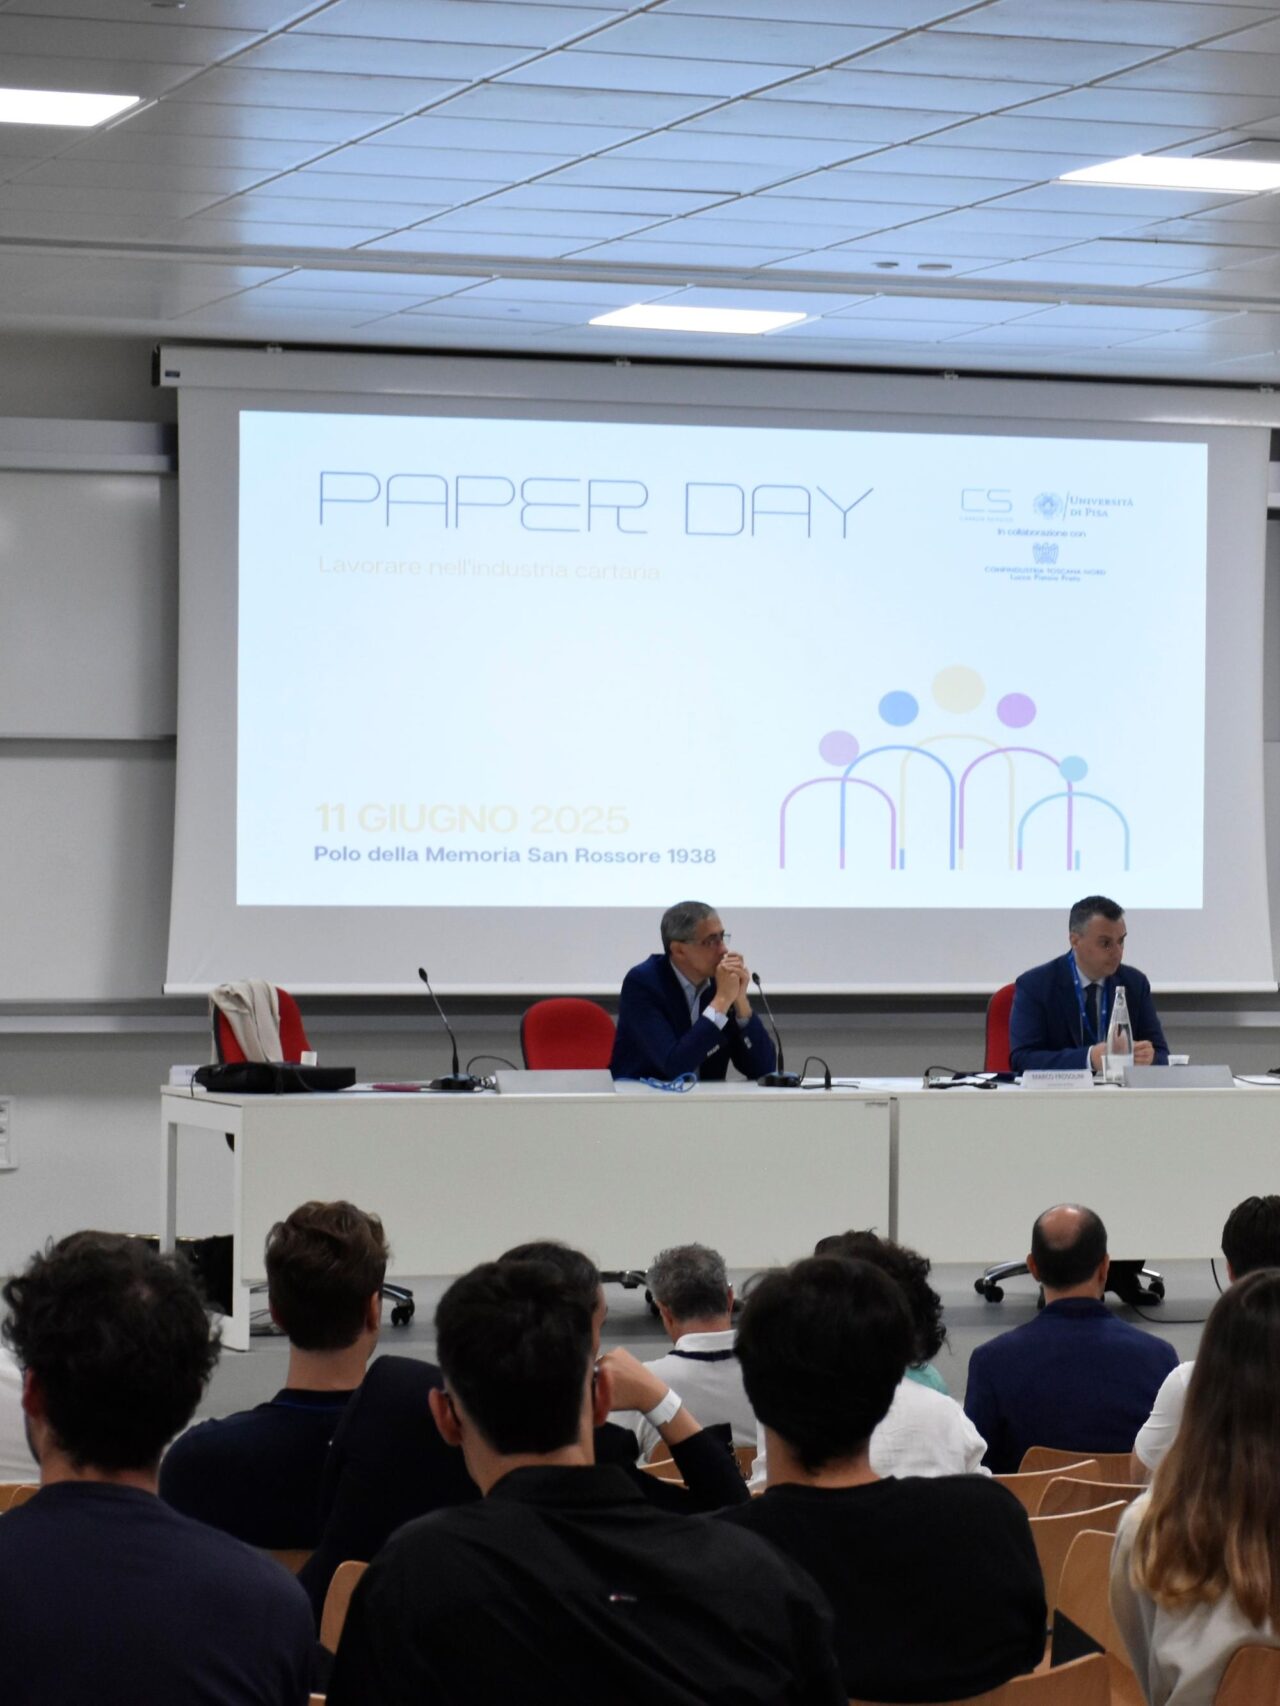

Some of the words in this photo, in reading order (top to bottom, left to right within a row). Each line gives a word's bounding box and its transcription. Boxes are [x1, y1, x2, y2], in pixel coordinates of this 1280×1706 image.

[319, 470, 649, 535] PAPER
[684, 481, 875, 539] DAY
[960, 487, 1013, 513] CS
[1069, 496, 1134, 507] UNIVERSITÀ
[1085, 507, 1108, 517] PISA
[1007, 528, 1068, 538] collaborazione
[317, 554, 422, 576] Lavorare
[428, 557, 569, 580] nell'industria
[575, 561, 661, 582] cartaria
[314, 803, 348, 833] 11
[357, 802, 519, 835] GIUGNO
[530, 803, 631, 836] 2025
[313, 845, 362, 862] Polo
[367, 845, 420, 863] della
[425, 846, 521, 864] Memoria
[527, 847, 569, 864] San
[575, 847, 661, 864] Rossore
[667, 847, 717, 864] 1938
